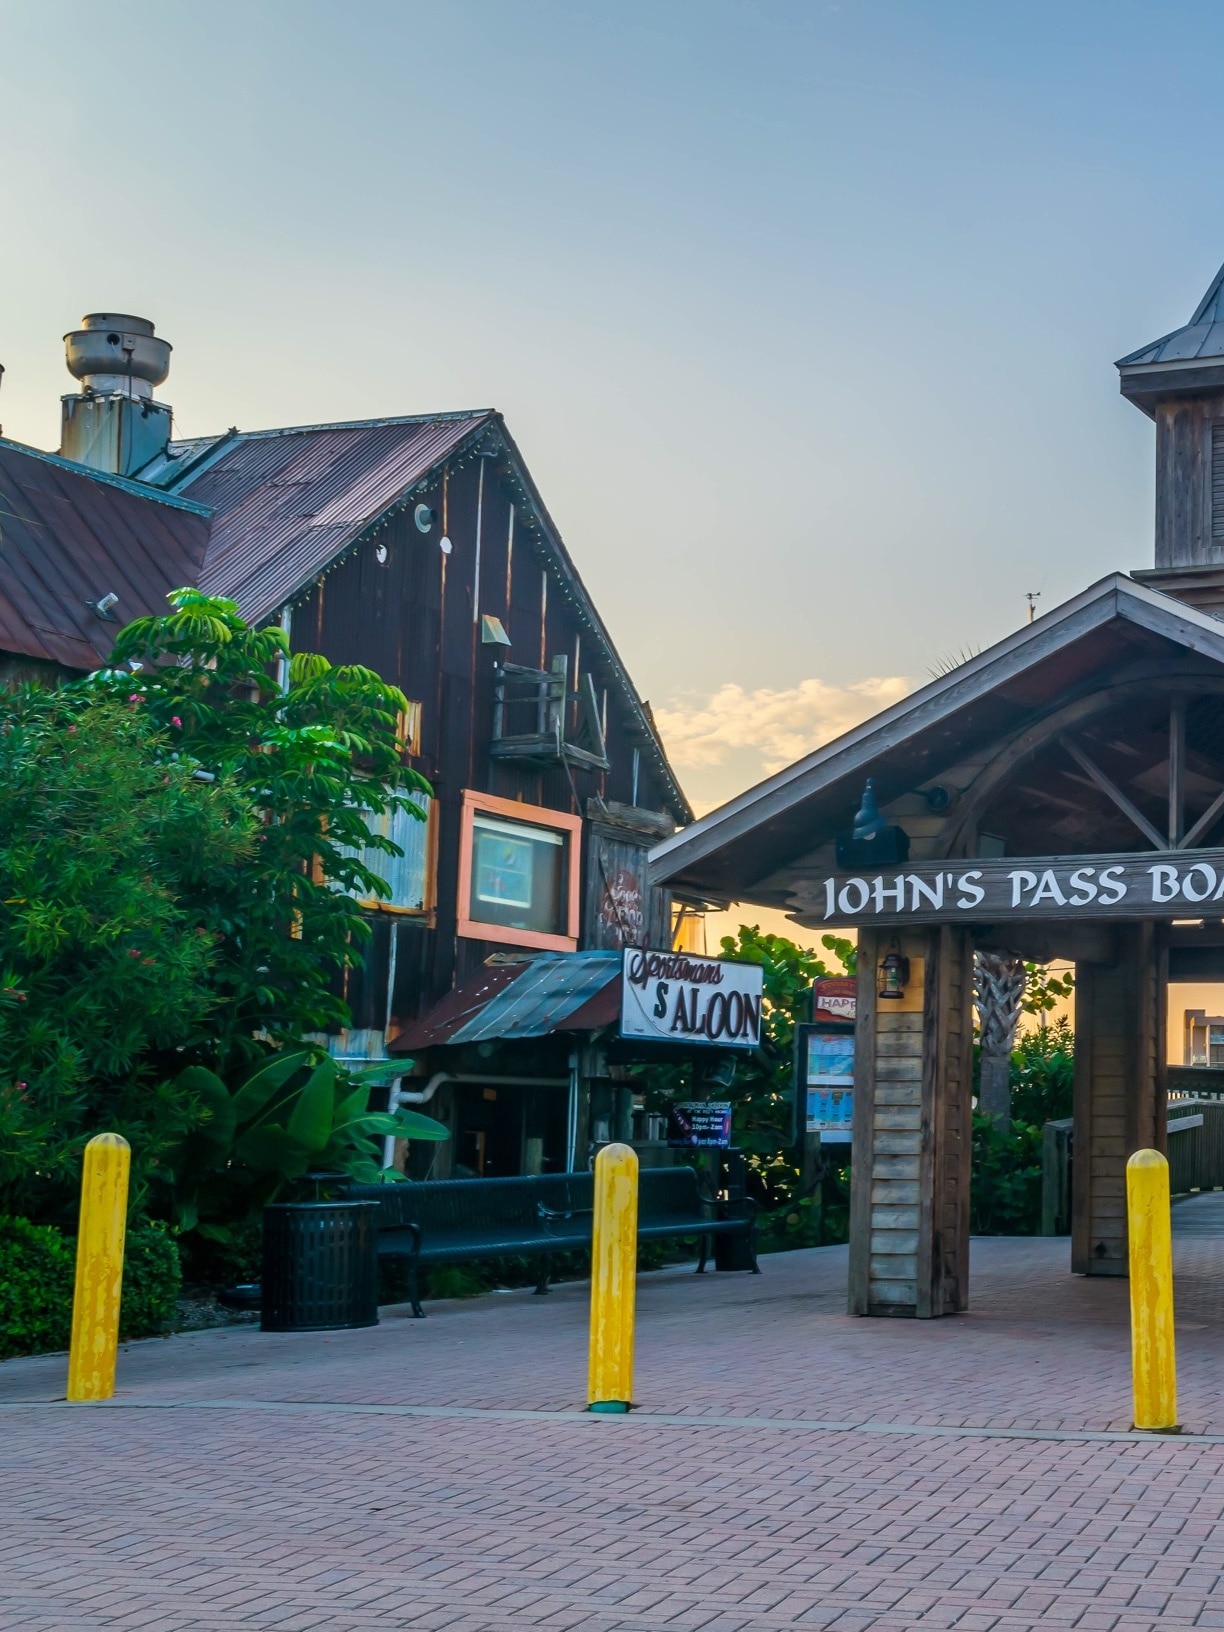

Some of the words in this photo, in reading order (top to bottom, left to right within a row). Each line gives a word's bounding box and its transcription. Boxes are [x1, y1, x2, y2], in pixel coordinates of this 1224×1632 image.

[823, 870, 986, 920] JOHN'S
[1006, 866, 1128, 908] PASS
[629, 937, 724, 990] Sportsmans
[653, 981, 762, 1041] SALOON
